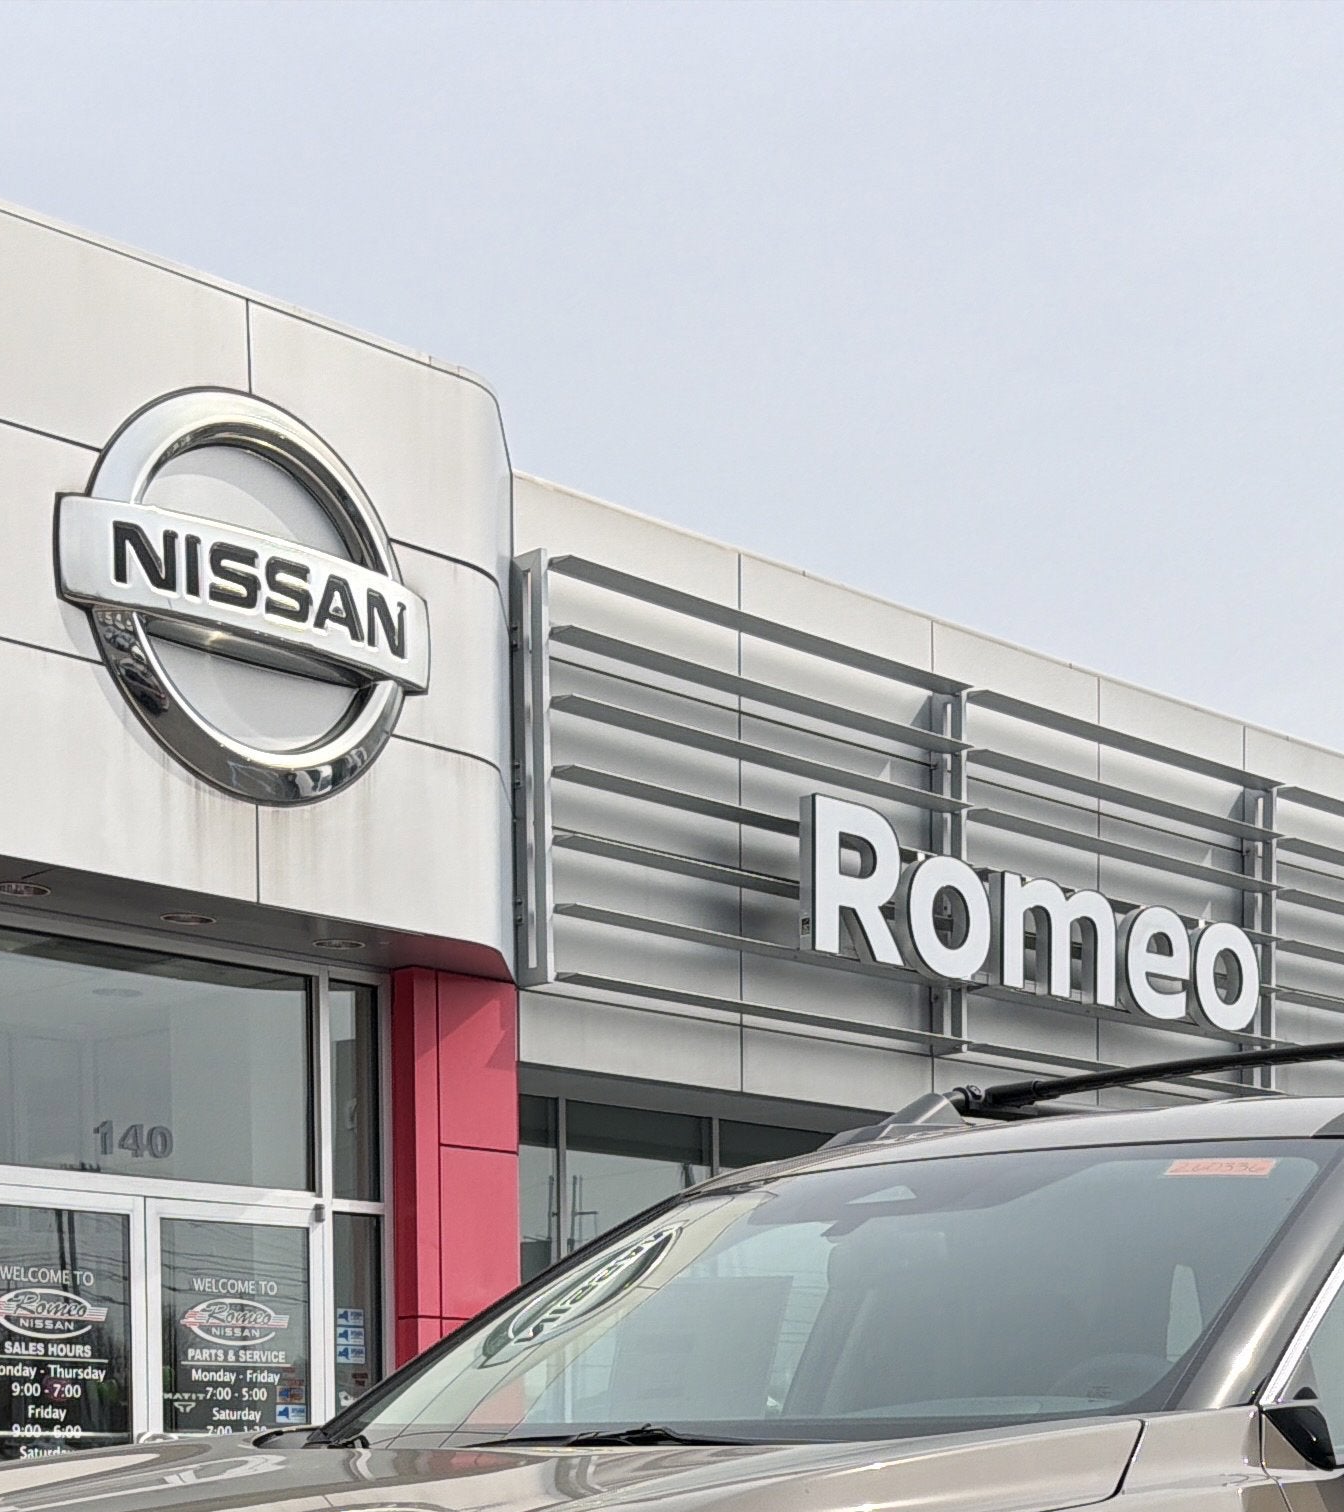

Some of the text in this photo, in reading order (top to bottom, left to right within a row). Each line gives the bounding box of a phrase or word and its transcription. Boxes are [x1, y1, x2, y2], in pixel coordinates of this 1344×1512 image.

[112, 519, 408, 661] NISSAN
[802, 792, 1261, 1034] Romeo
[93, 1120, 174, 1159] 140
[0, 1265, 94, 1287] WELCOME TO
[193, 1277, 278, 1296] WELCOME TO
[5, 1290, 88, 1318] Romeo
[200, 1301, 272, 1326] Romeo
[19, 1317, 75, 1331] NISSAN
[211, 1326, 261, 1338] NISSAN
[4, 1341, 92, 1358] SALES HOURS
[187, 1347, 286, 1363] PARTS & SERVICE
[47, 1363, 106, 1383] Thursday
[191, 1367, 237, 1386] Monday
[246, 1369, 281, 1386] Friday
[11, 1382, 42, 1397] 9:00
[52, 1383, 82, 1399] 7:00
[205, 1386, 232, 1401] 7:00
[241, 1387, 268, 1401] 5:00
[27, 1404, 67, 1422] Friday
[212, 1407, 262, 1423] Saturday
